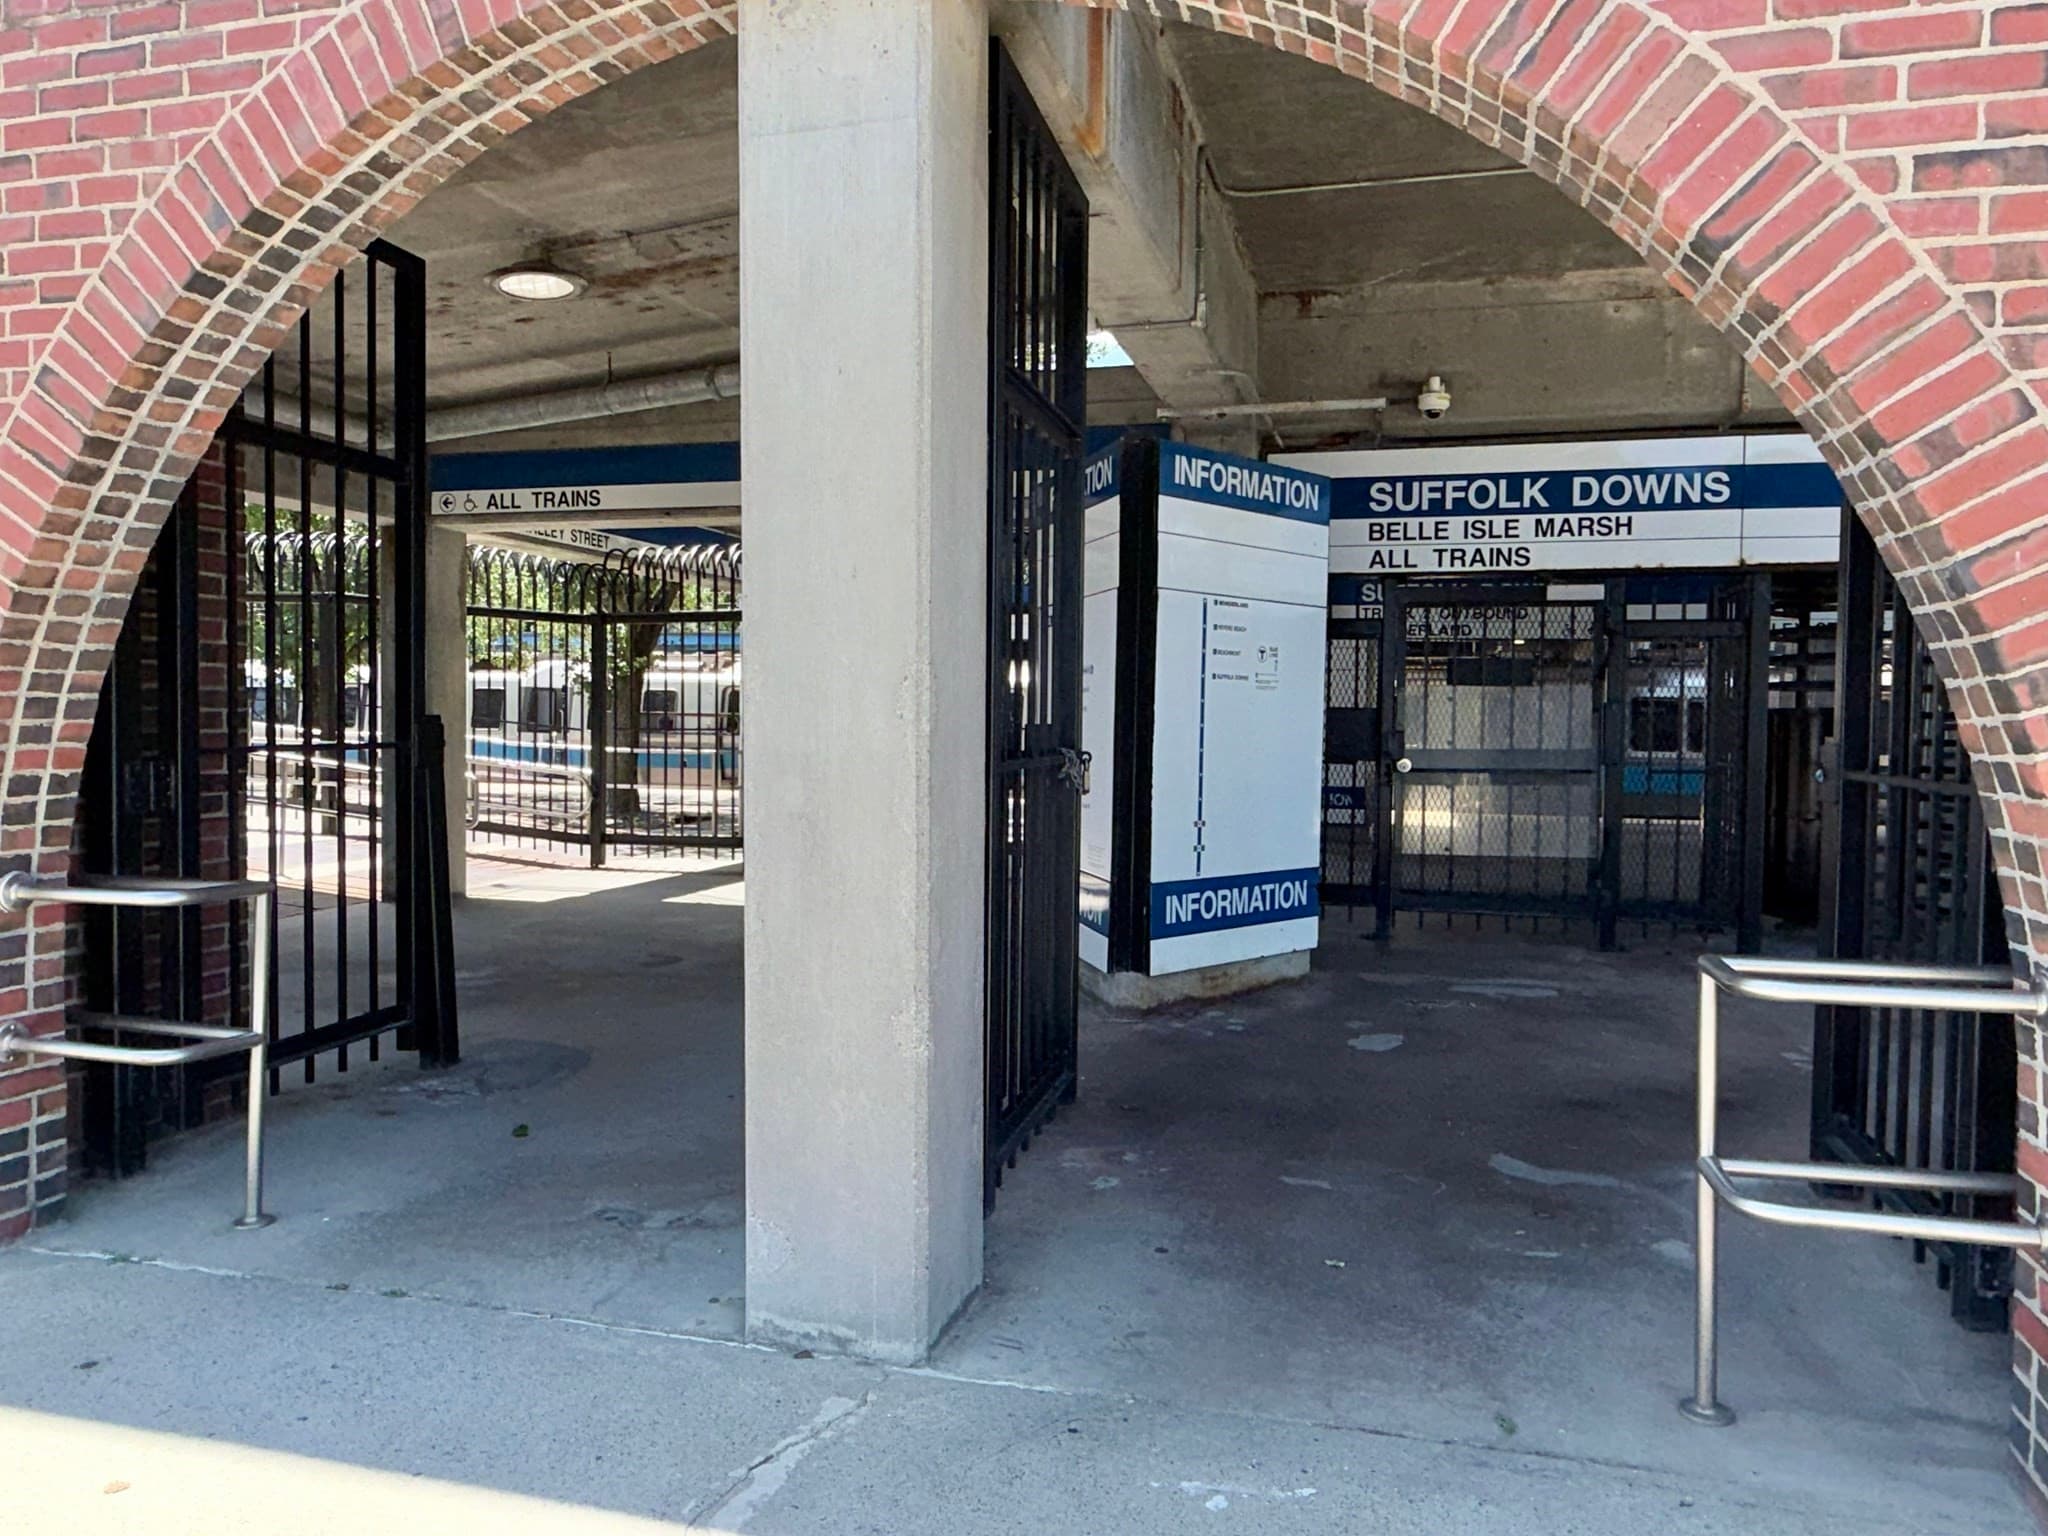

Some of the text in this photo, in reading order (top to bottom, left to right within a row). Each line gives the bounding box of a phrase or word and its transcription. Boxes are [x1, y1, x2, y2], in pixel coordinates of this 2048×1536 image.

[1174, 454, 1320, 512] INFORMATION
[1369, 471, 1731, 512] SUFFOLK DOWNS
[486, 489, 601, 510] ALL TRAINS
[570, 528, 610, 549] STREET
[1368, 515, 1633, 542] BELLE ISLE MARSH
[1369, 546, 1531, 569] ALL TRAINS
[1165, 880, 1308, 925] INFORMATION
